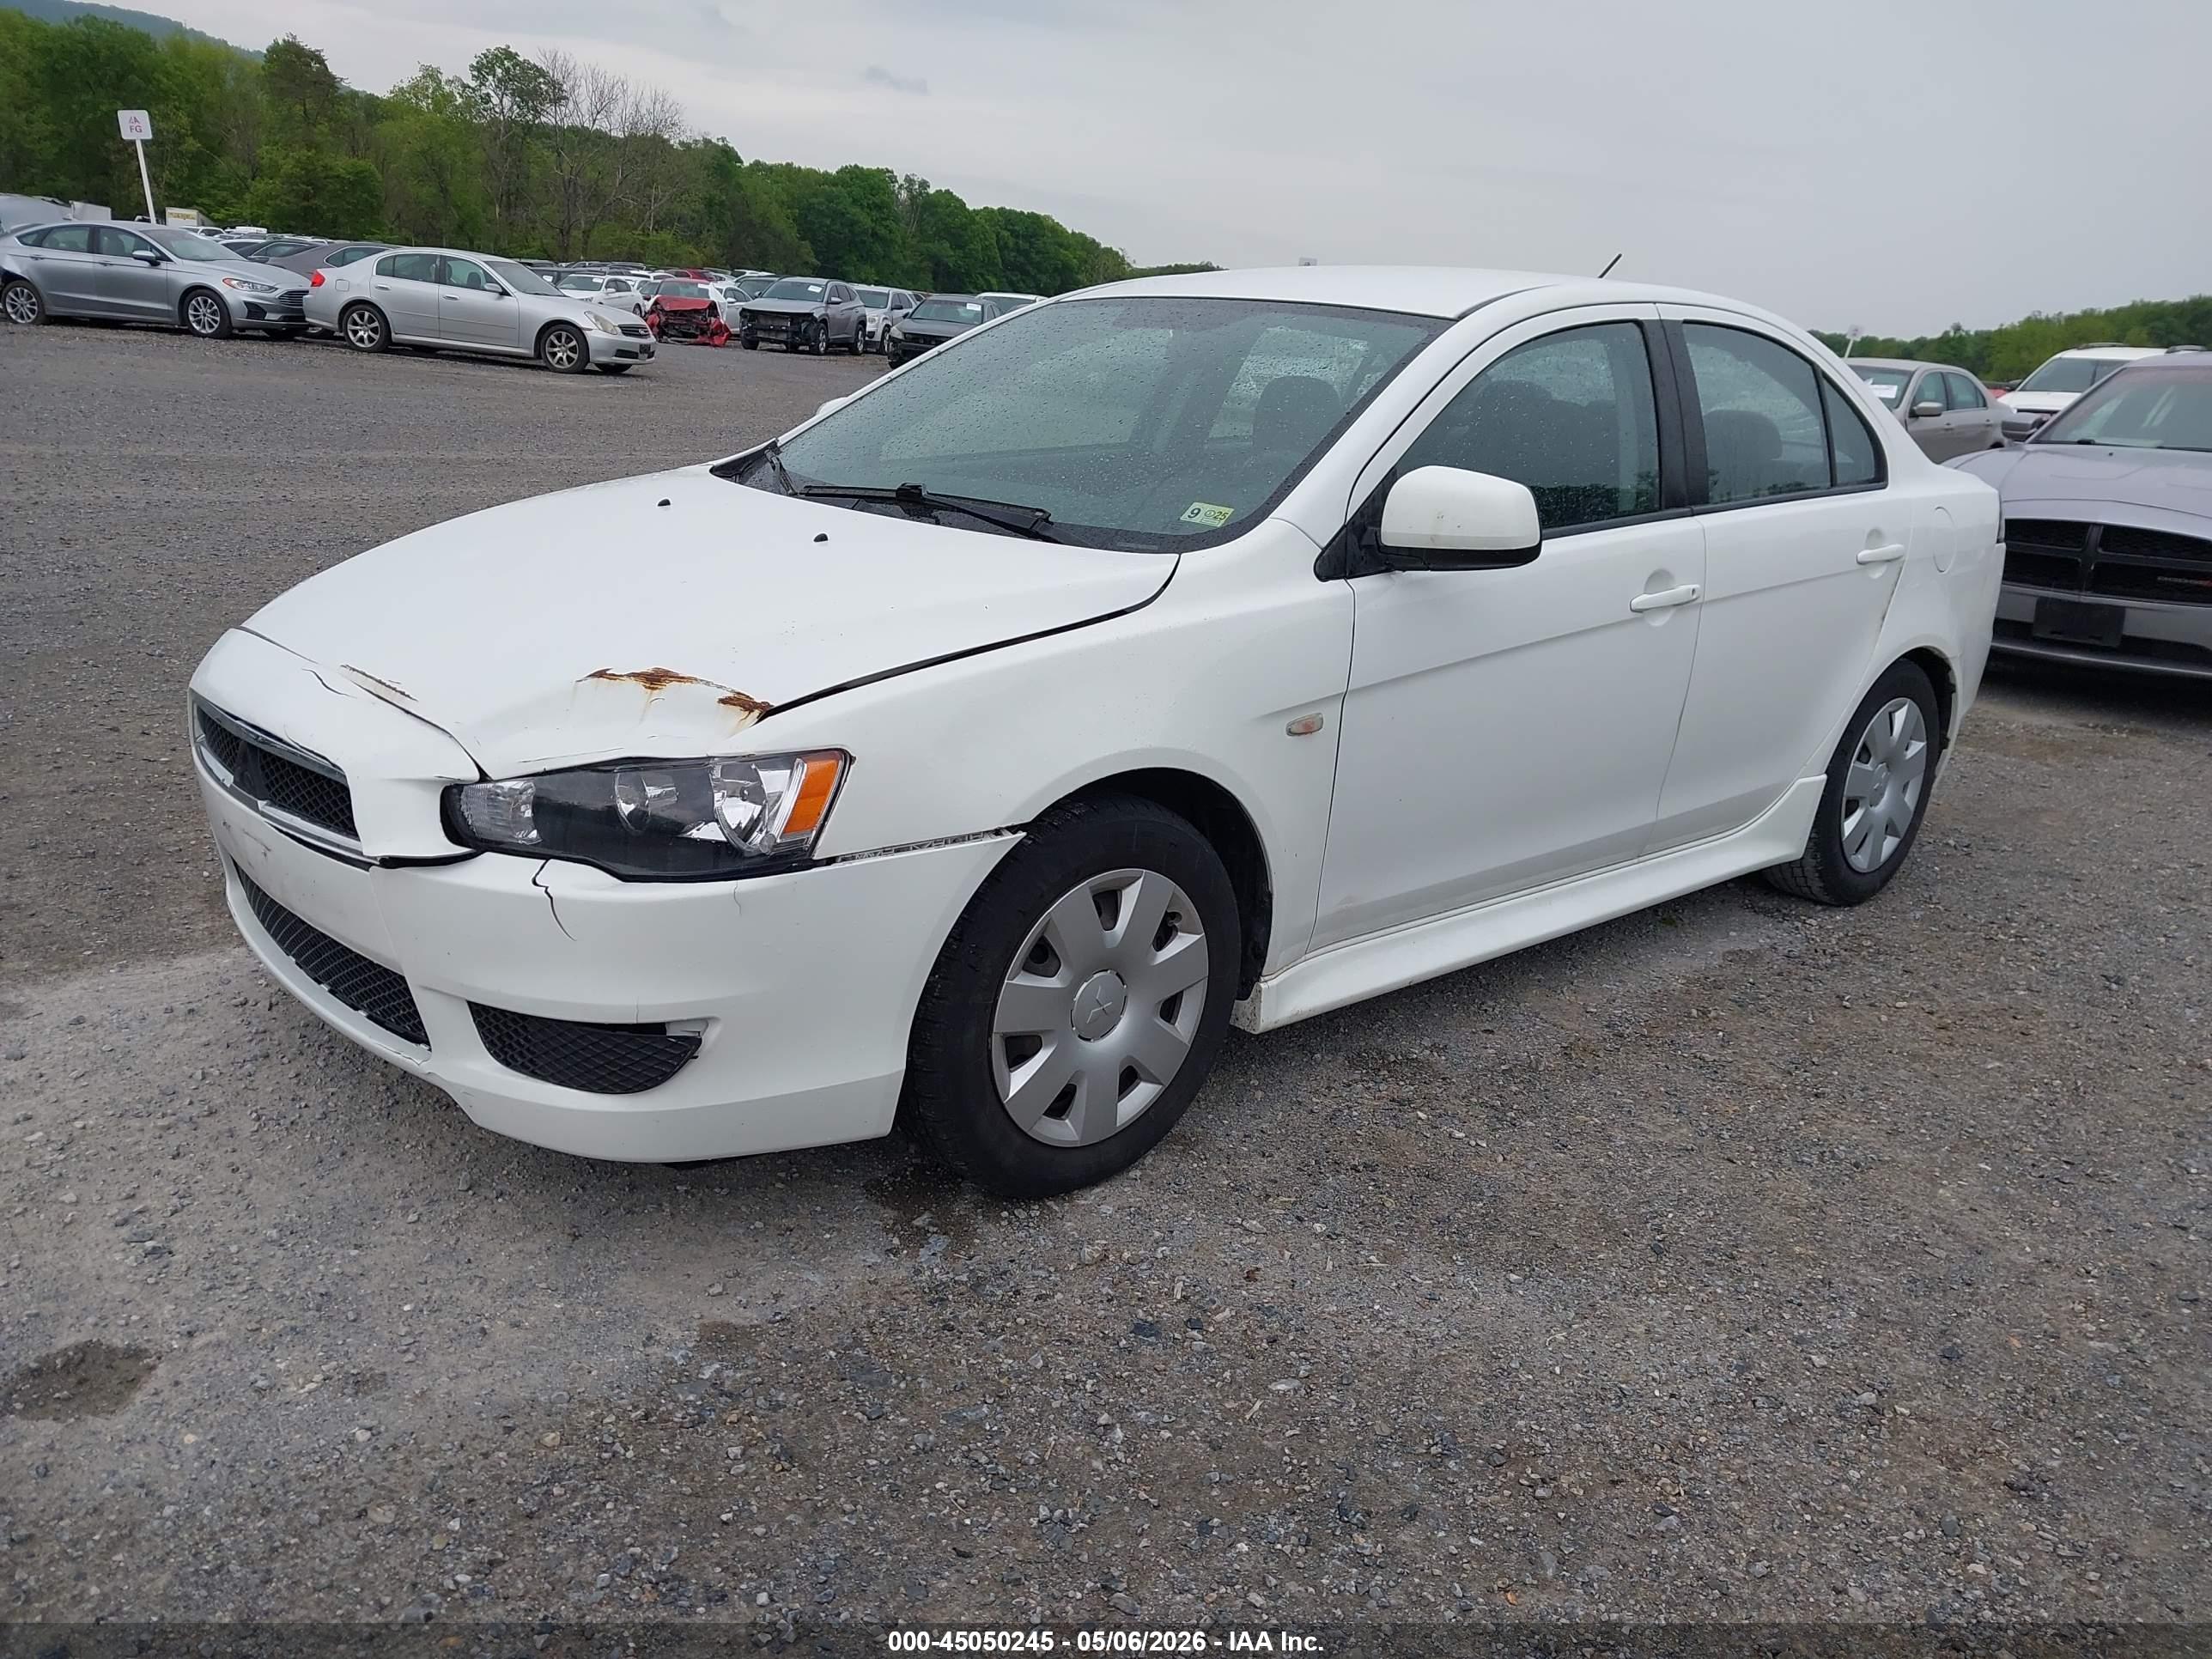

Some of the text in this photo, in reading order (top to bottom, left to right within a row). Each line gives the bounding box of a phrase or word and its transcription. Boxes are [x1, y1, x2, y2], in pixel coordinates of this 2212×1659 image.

[130, 125, 143, 133] FG
[1188, 508, 1229, 520] 9 25
